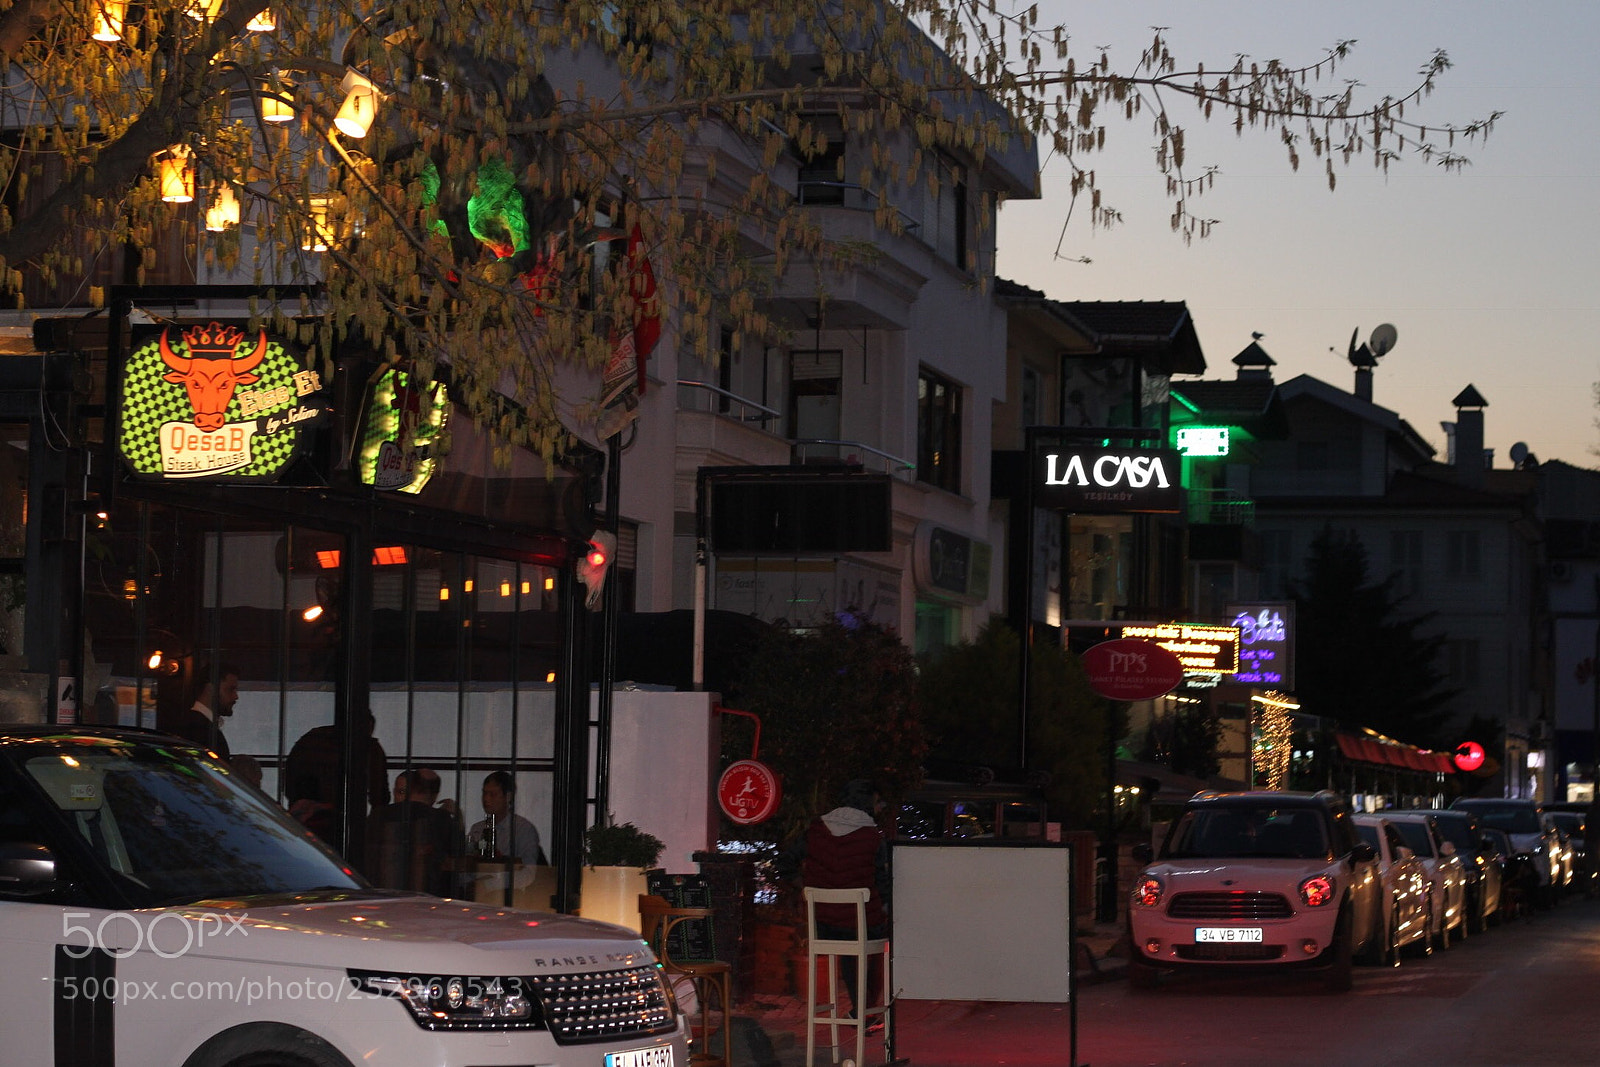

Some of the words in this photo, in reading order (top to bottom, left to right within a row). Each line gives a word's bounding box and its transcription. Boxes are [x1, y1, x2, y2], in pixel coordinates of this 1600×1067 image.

[292, 370, 322, 397] Et
[266, 417, 281, 435] by
[280, 405, 320, 425] Selim
[167, 456, 201, 471] Steak
[207, 452, 246, 468] House
[1045, 454, 1090, 486] LA
[1092, 455, 1171, 489] CASA
[1201, 929, 1215, 941] 34
[1219, 929, 1235, 941] VB
[1238, 929, 1261, 941] 7112
[535, 955, 598, 968] RANGE
